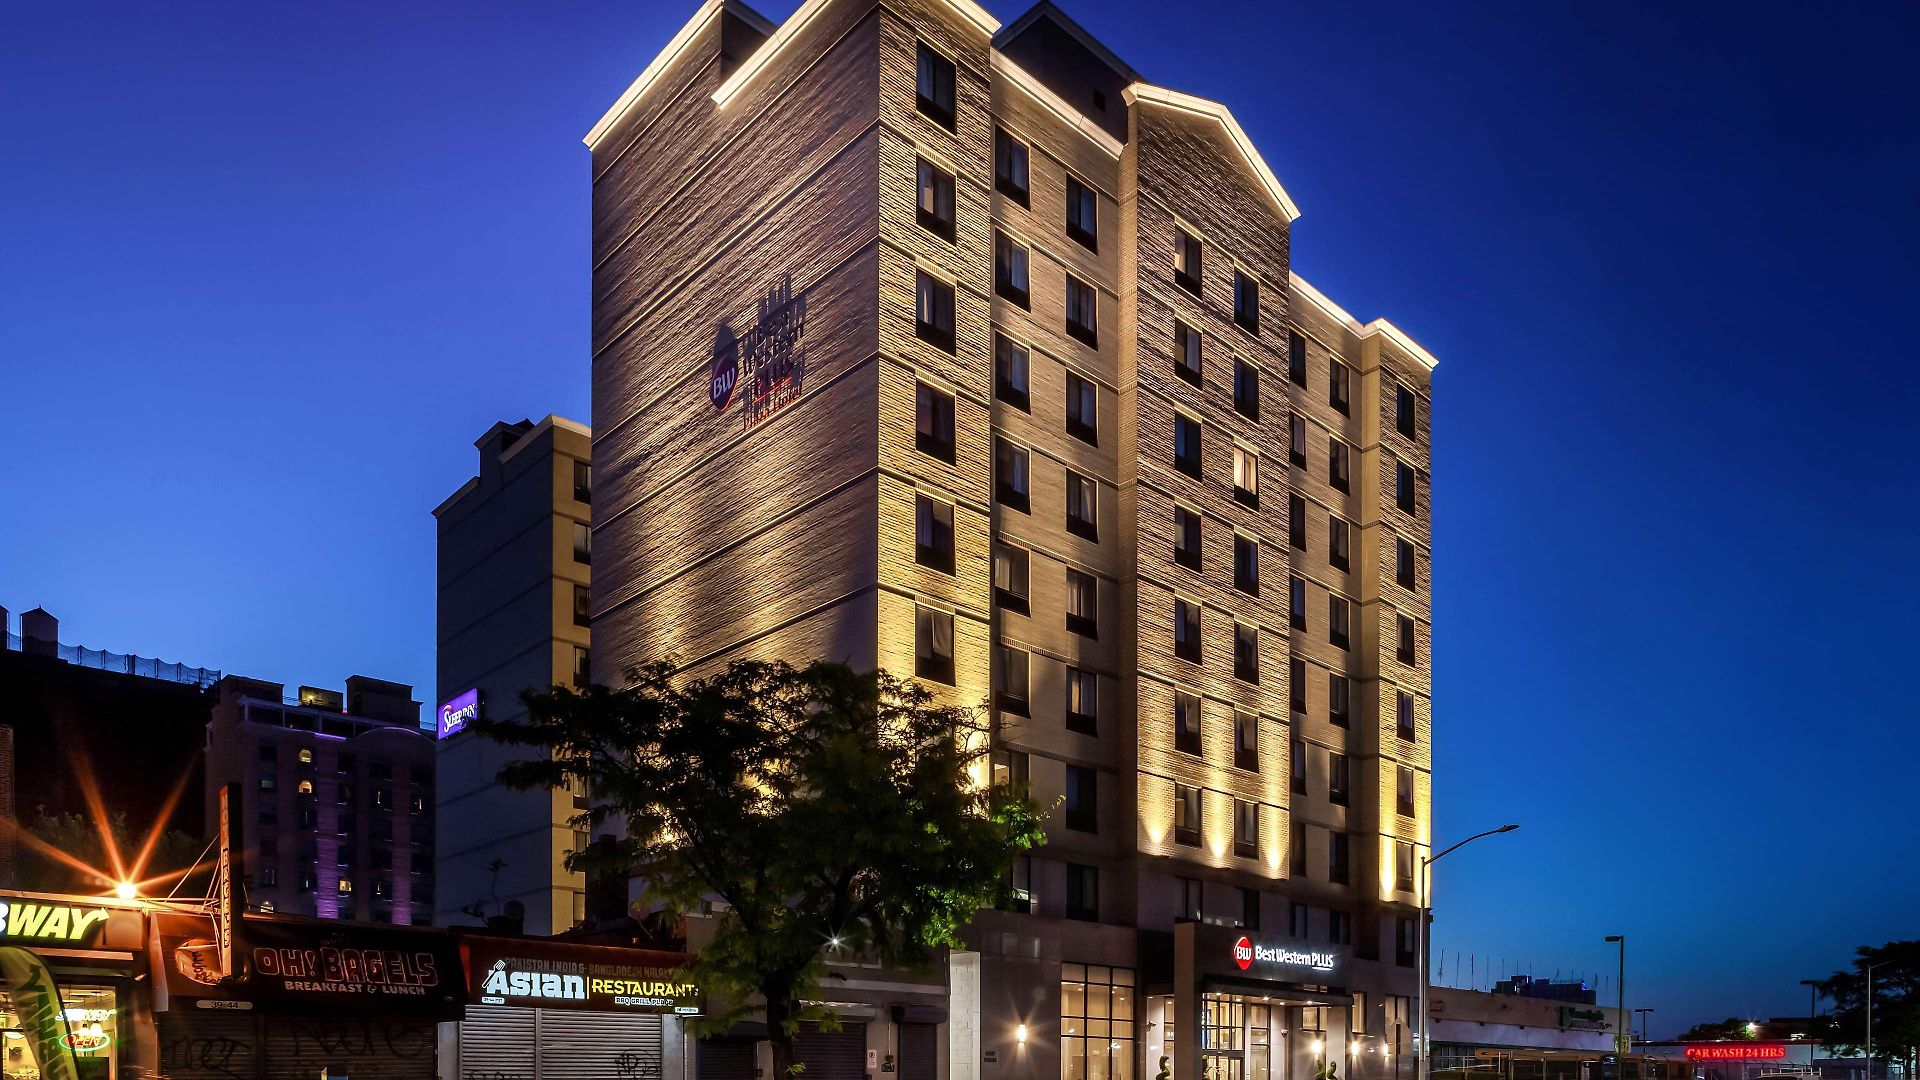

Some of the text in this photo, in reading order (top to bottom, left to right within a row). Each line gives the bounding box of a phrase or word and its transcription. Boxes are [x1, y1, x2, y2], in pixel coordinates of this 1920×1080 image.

[713, 367, 735, 399] BW
[1237, 946, 1333, 968] BW Best Western PLUS
[253, 947, 316, 977] OH!
[319, 947, 440, 987] BAGELS
[505, 958, 549, 973] PAKISTAN
[553, 961, 577, 974] INDIA
[284, 981, 425, 995] BREAKFAST & LUNCH
[486, 970, 695, 999] Asian RESTAURANT
[211, 1001, 238, 1009] 39-44
[615, 997, 630, 1006] BBQ
[631, 997, 650, 1005] GRILL
[1687, 1047, 1785, 1058] CAR WASH 24 HRS
